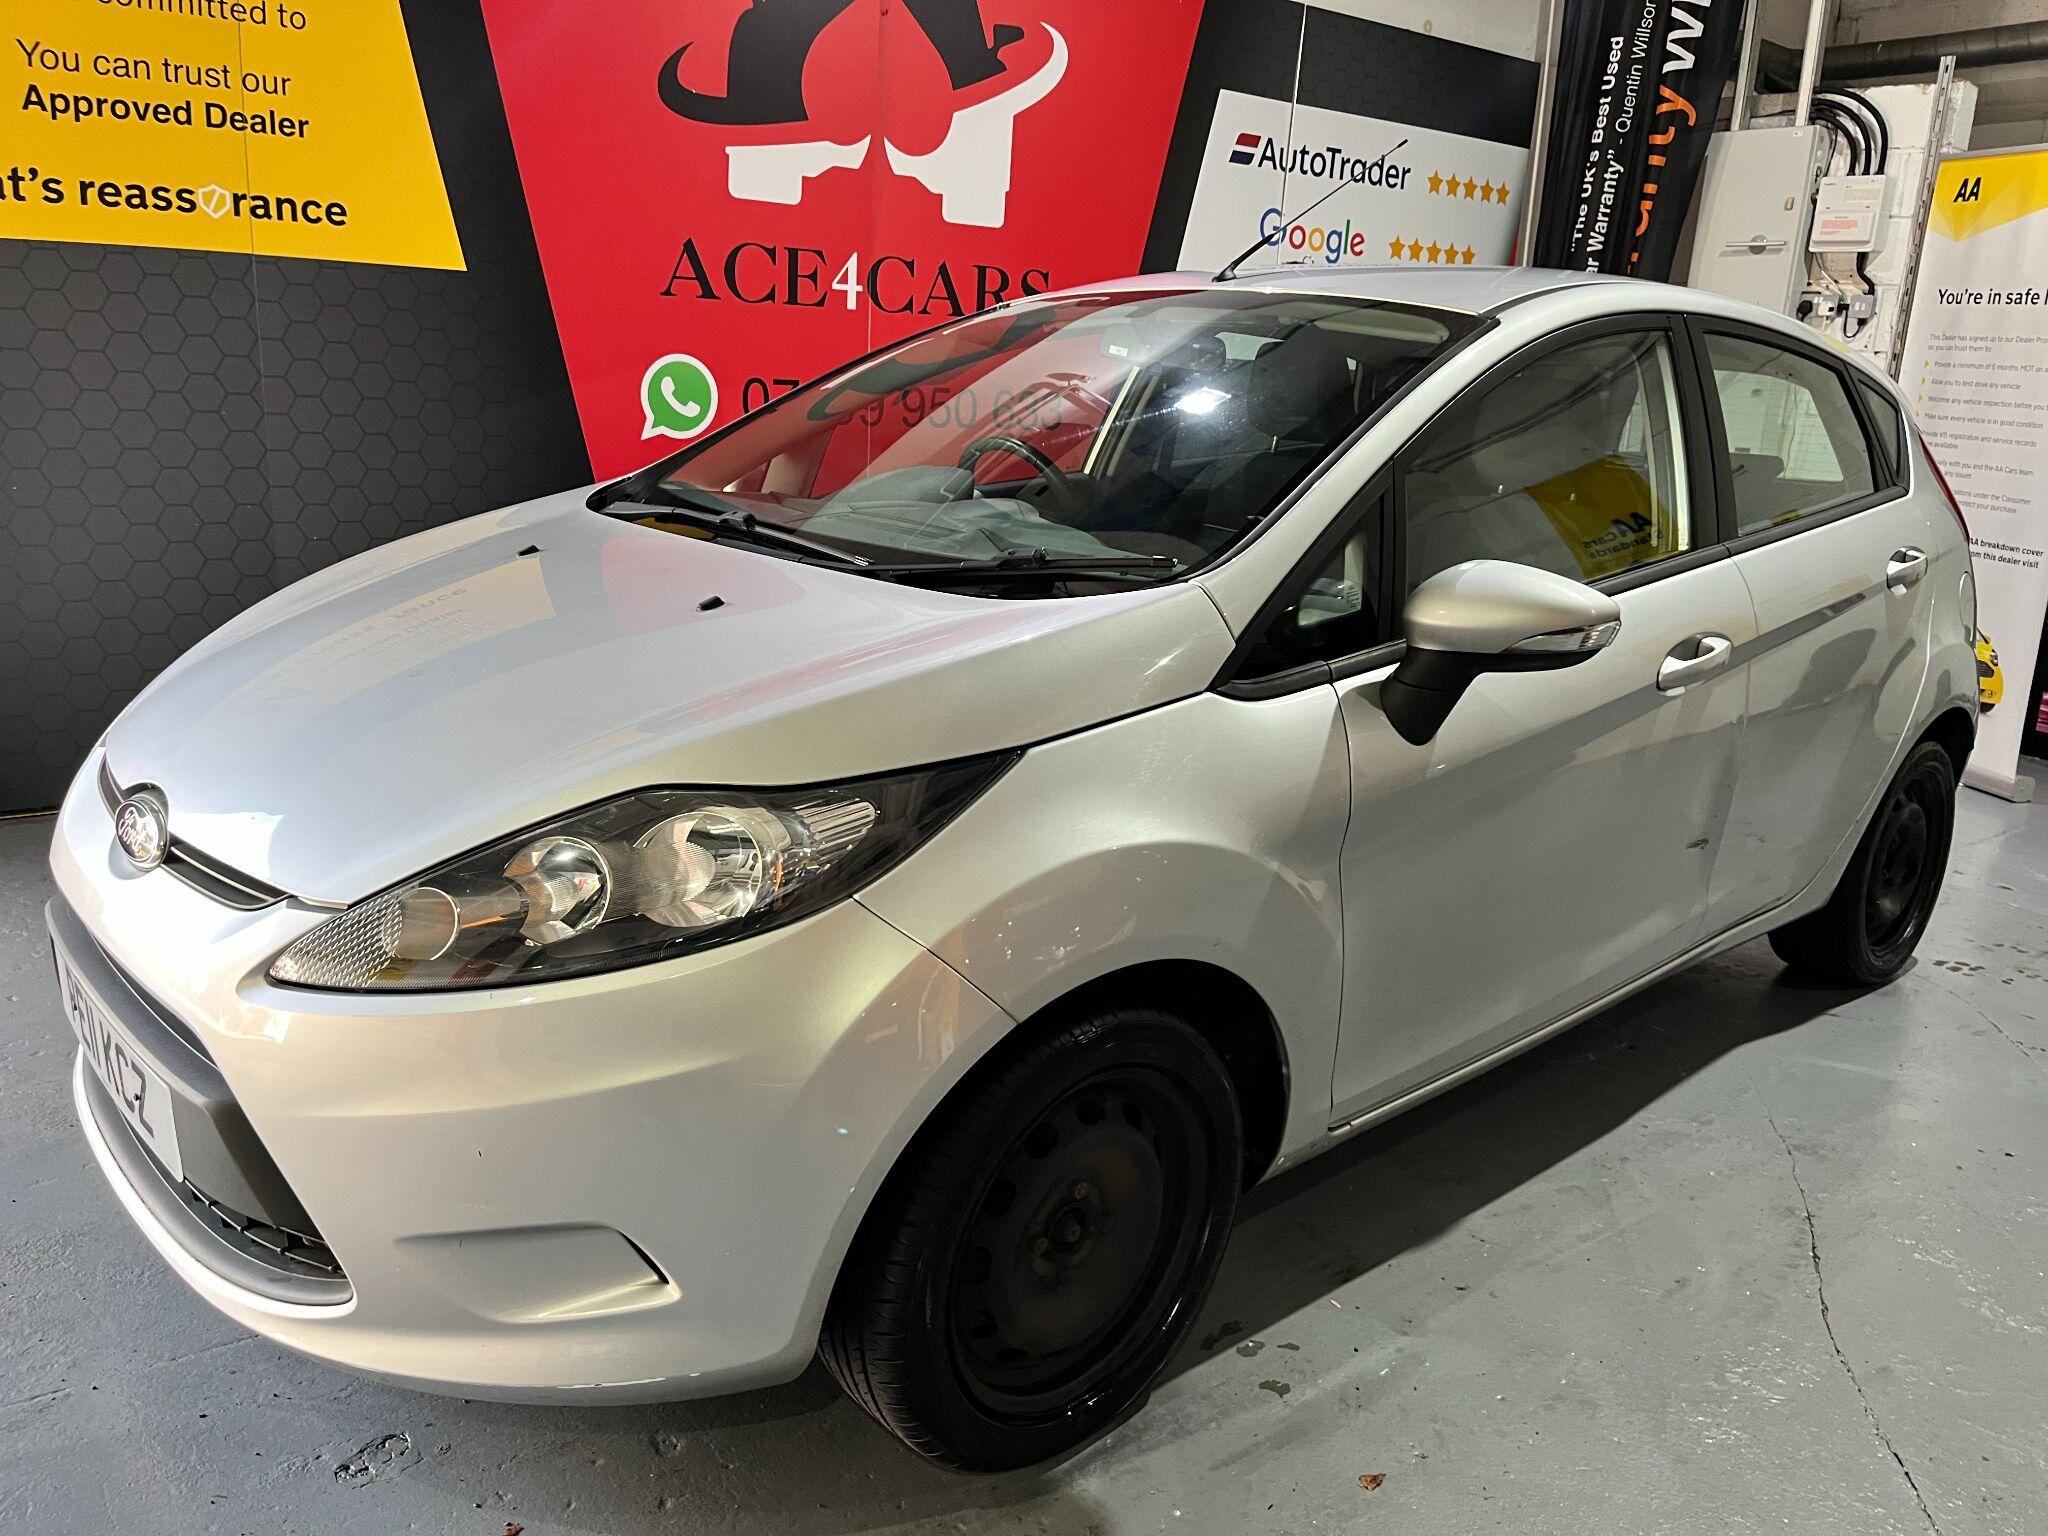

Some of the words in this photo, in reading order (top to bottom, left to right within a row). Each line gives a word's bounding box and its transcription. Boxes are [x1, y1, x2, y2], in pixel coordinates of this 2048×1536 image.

[97, 0, 267, 25] mitted
[277, 3, 307, 30] to
[15, 38, 80, 73] You
[93, 53, 151, 81] can
[162, 56, 231, 89] trust
[241, 69, 292, 97] our
[1601, 36, 1624, 90] Used
[22, 83, 193, 126] Approved
[205, 102, 310, 138] Dealer
[1615, 64, 1643, 133] Quentin
[1591, 96, 1612, 144] Best
[1258, 138, 1412, 190] AutoTrader
[1953, 177, 1982, 203] AA
[1260, 207, 1366, 264] Google
[660, 236, 1051, 317] ACE4CARS
[1938, 288, 1983, 305] You're
[1987, 288, 2001, 305] in
[2005, 288, 2040, 305] safe
[1969, 335, 1989, 343] signed
[1983, 400, 2013, 408] inspection
[1949, 432, 1980, 441] registration
[1993, 437, 2014, 445] service
[2000, 419, 2015, 427] good
[2016, 421, 2043, 429] condition
[1990, 505, 2017, 514] purchase
[1981, 540, 2020, 553] breakdown
[2022, 548, 2044, 557] cover
[1983, 552, 1996, 561] this
[1998, 555, 2021, 565] dealer
[2022, 560, 2039, 569] visit
[99, 1018, 155, 1139] KCZ
